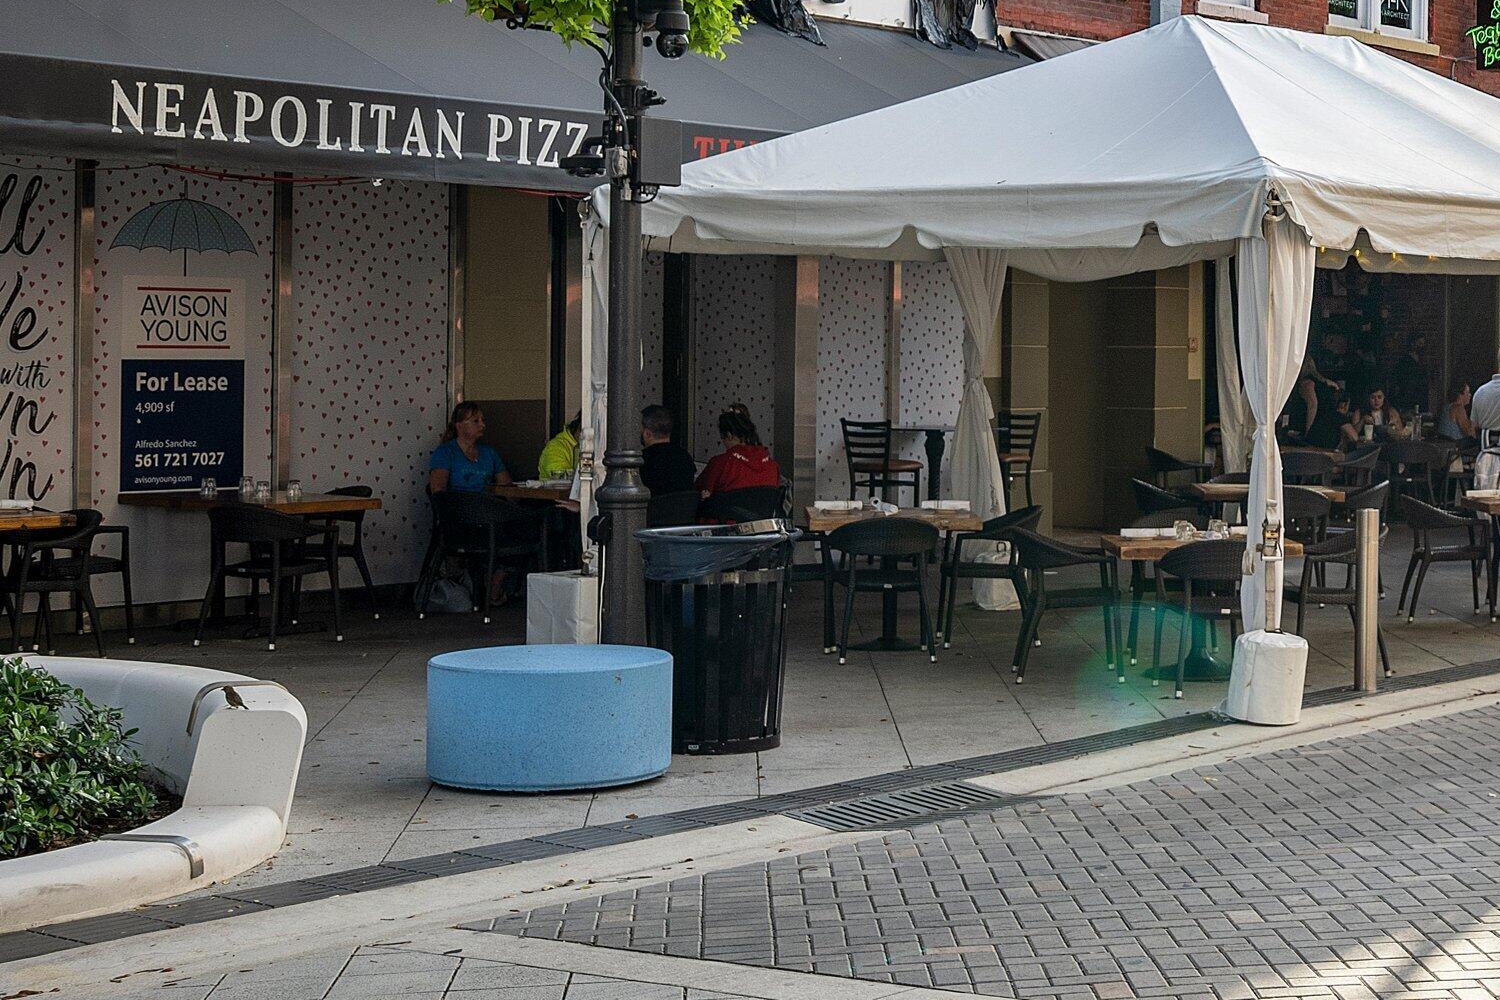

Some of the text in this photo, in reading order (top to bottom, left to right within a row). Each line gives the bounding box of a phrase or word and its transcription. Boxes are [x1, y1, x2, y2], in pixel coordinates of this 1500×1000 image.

[110, 79, 465, 160] NEAPOLITAN
[140, 294, 227, 317] AVISON
[140, 319, 227, 343] YOUNG
[0, 360, 51, 389] with
[136, 371, 229, 392] For Lease
[135, 401, 175, 414] 4,909 sf
[135, 439, 197, 449] Alfredo Sanchez
[134, 451, 225, 468] 561 721 7027
[134, 474, 193, 485] avisonyoung.com
